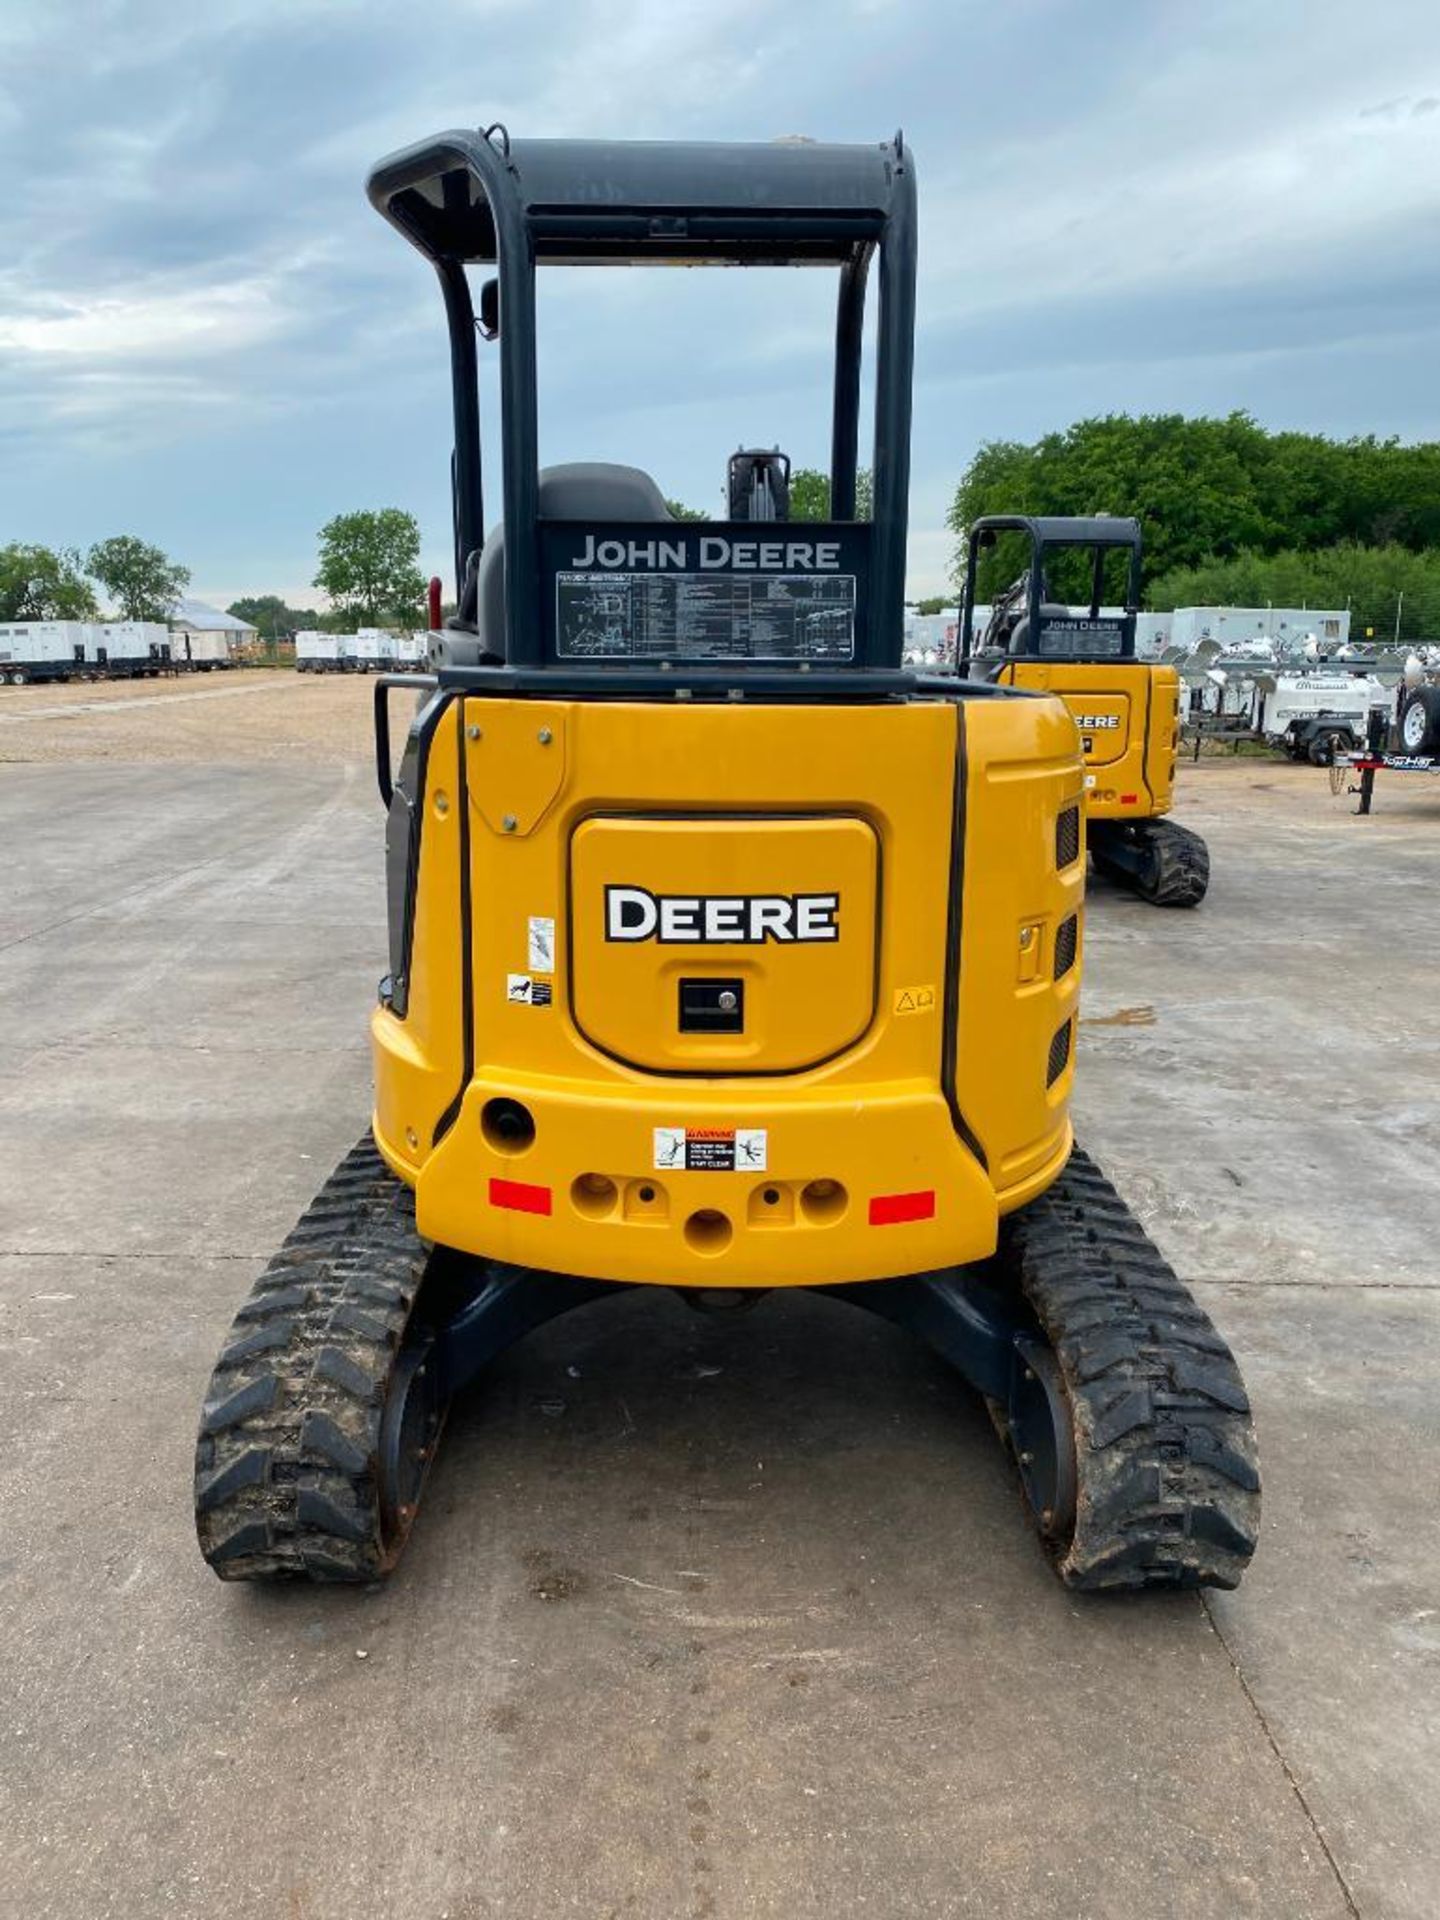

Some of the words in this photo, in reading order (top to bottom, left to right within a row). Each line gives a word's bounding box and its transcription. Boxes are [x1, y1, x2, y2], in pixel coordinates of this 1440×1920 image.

[572, 535, 686, 569] JOHN
[700, 537, 841, 569] DEERE
[1074, 715, 1119, 728] EERE
[606, 886, 839, 942] DEERE
